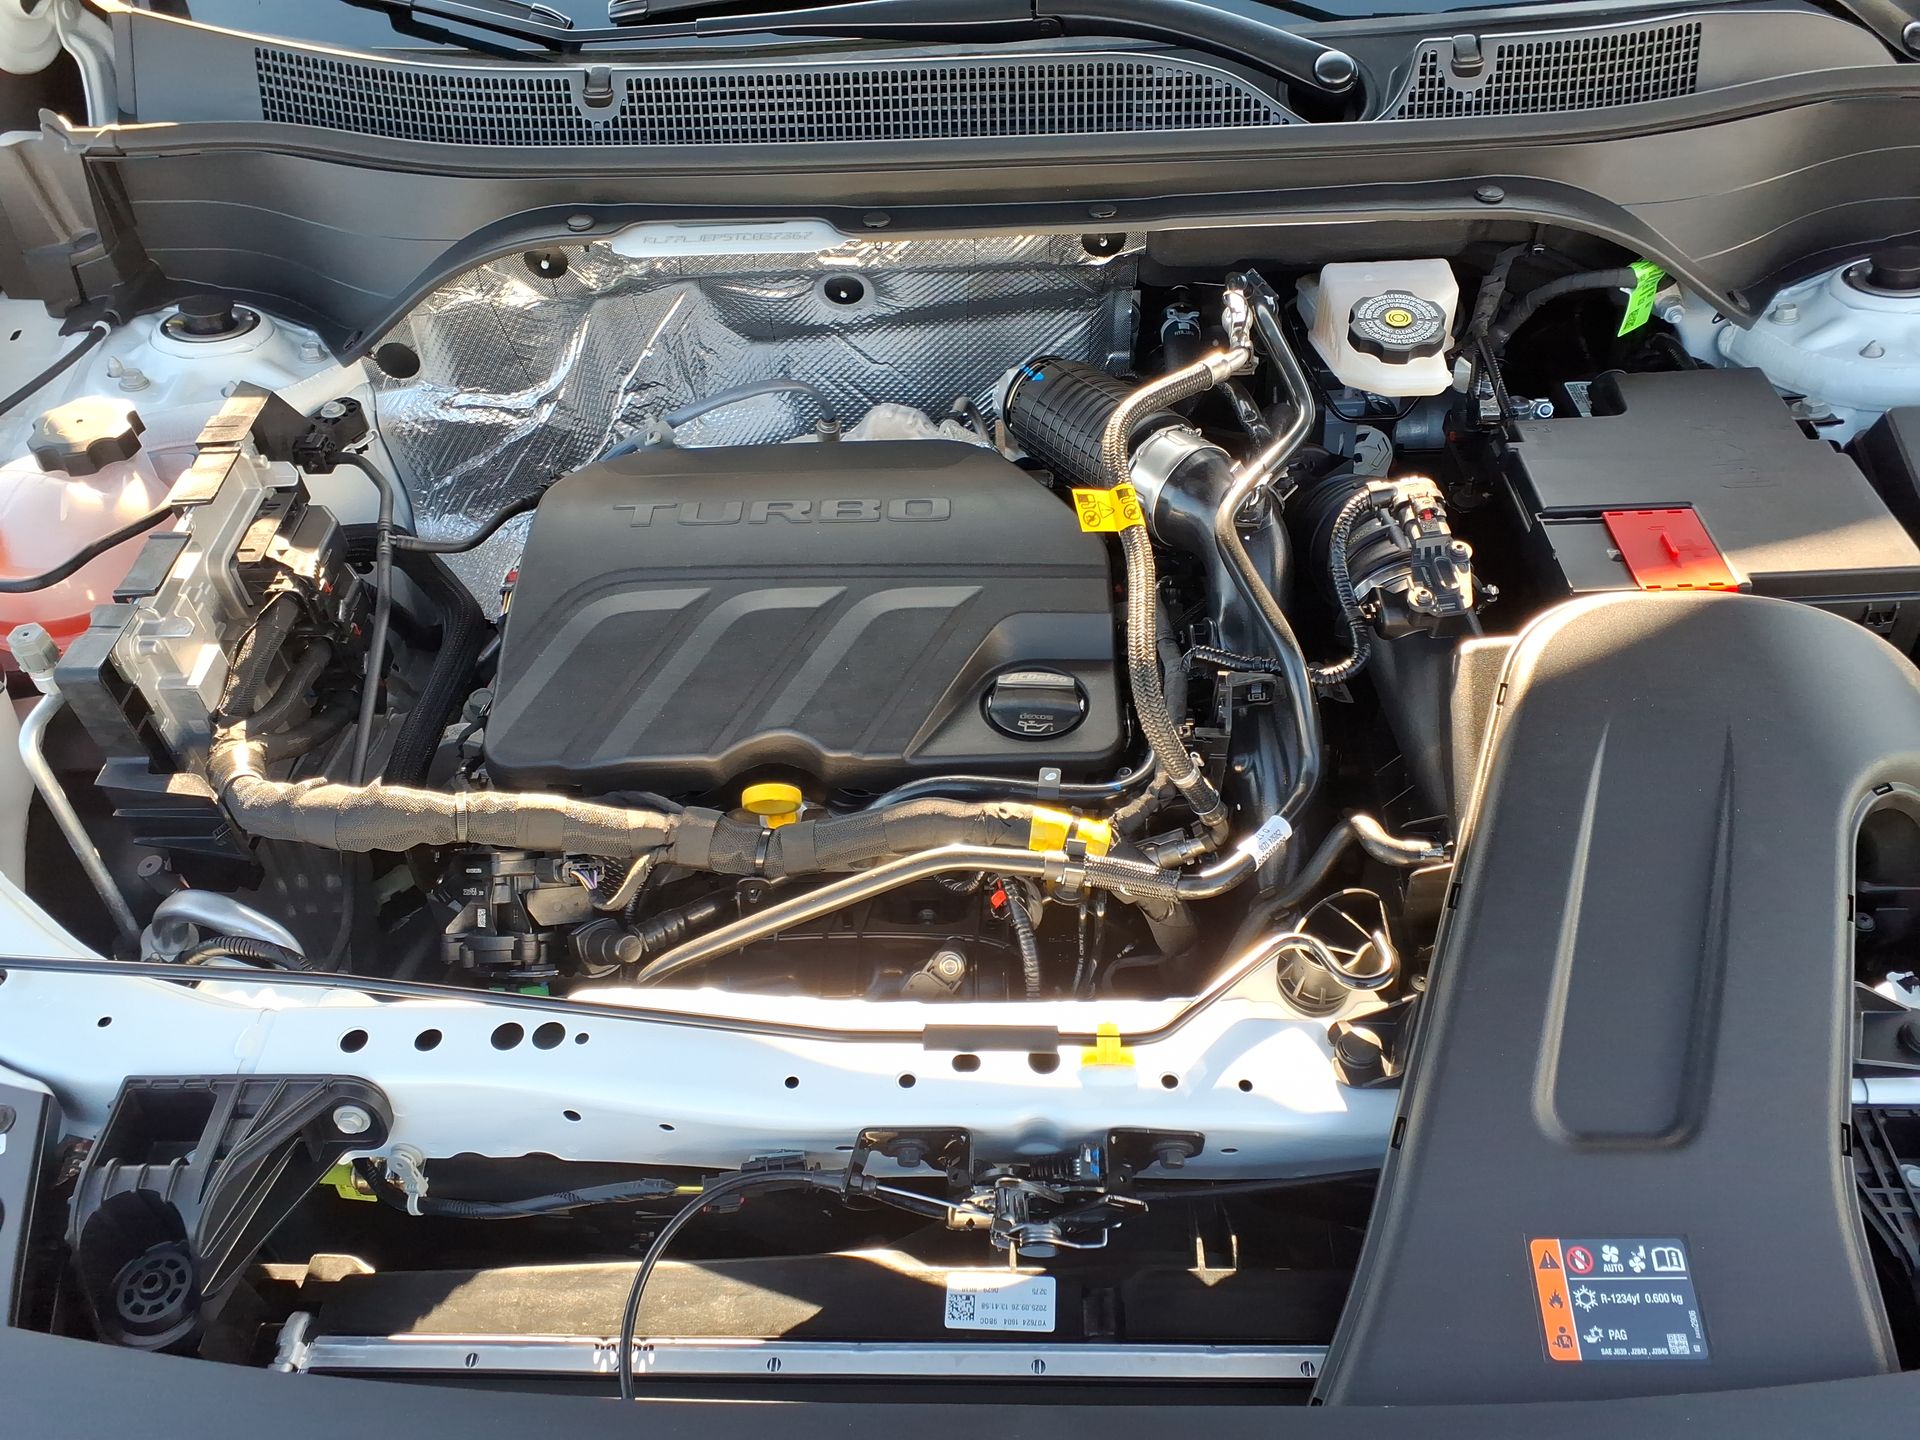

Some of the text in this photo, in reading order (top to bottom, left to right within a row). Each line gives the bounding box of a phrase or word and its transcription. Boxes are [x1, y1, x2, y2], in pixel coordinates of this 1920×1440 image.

[1380, 336, 1397, 344] FROM
[613, 499, 951, 527] TURBO
[1603, 1264, 1624, 1273] AUTO
[1600, 1293, 1684, 1305] R-1234yf 0.600 kg
[1608, 1329, 1628, 1341] PAG
